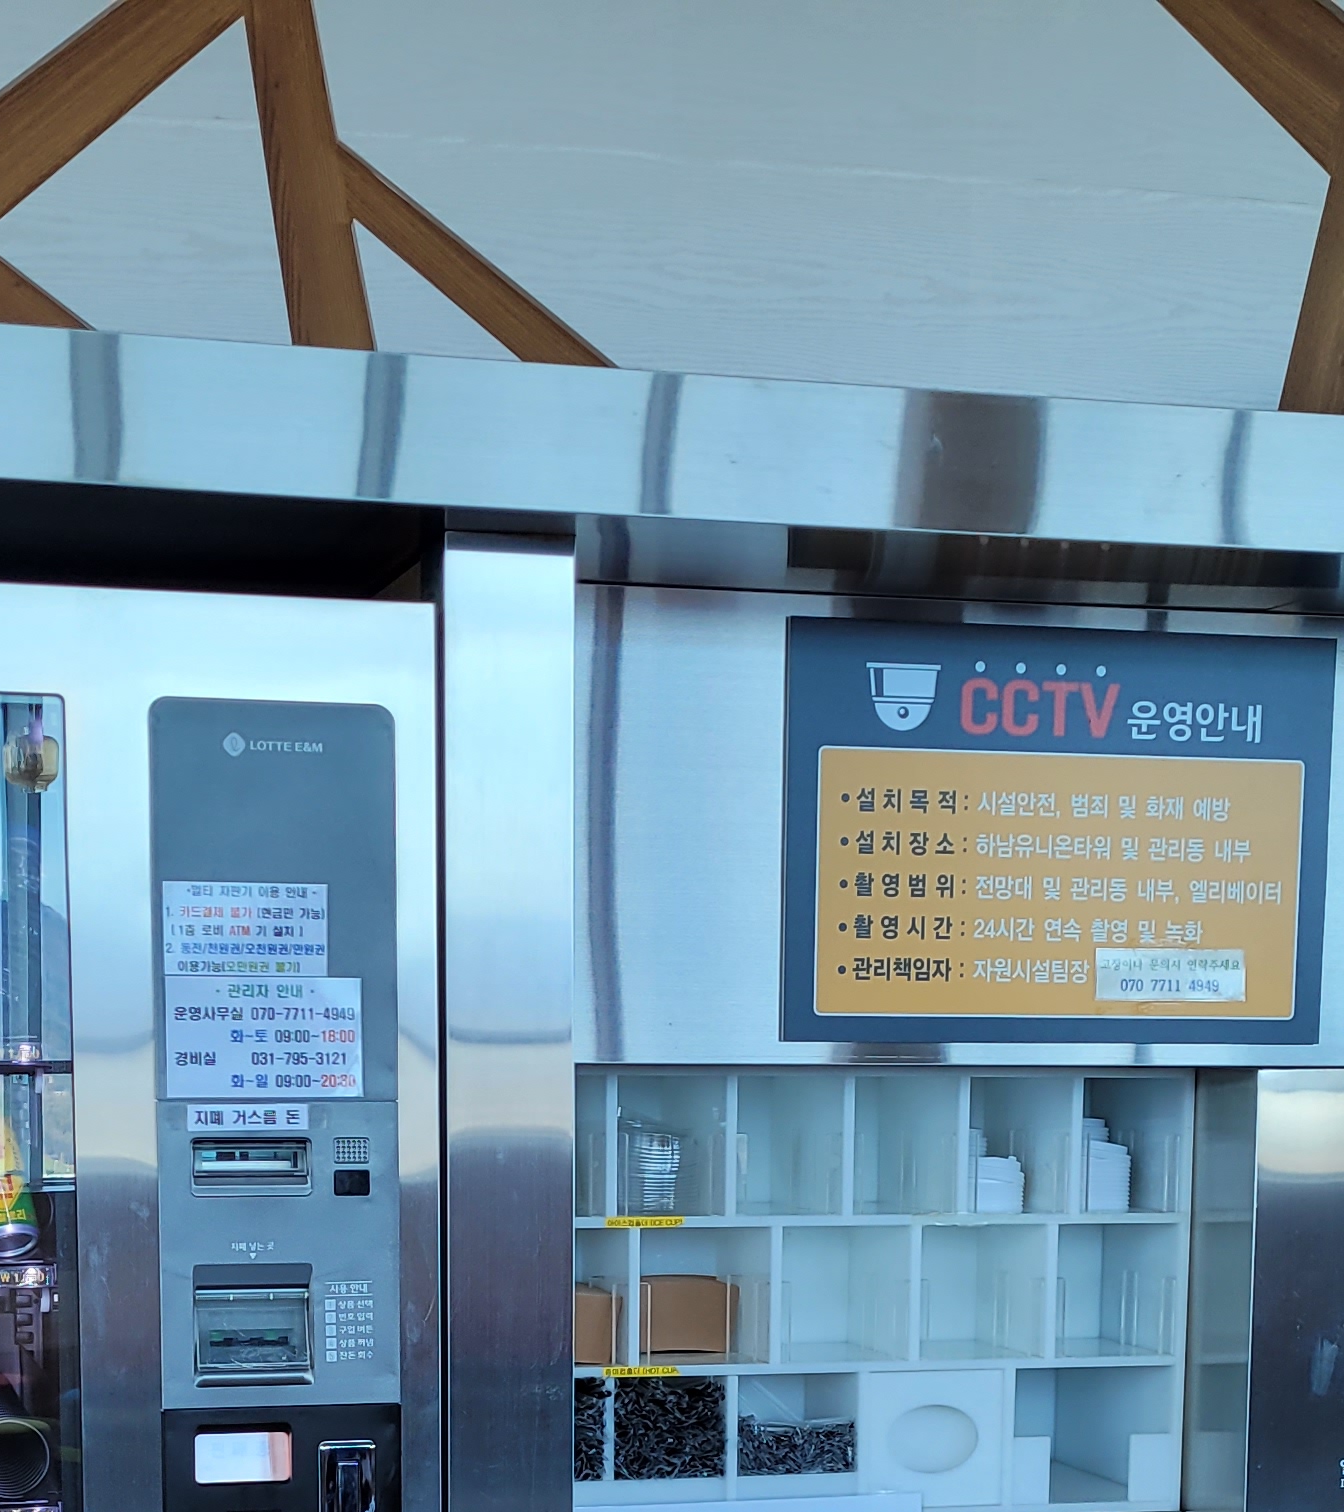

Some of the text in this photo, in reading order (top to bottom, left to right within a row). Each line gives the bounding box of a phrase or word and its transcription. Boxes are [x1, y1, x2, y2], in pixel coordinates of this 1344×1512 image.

[960, 677, 1263, 744] CCTV 운영안내
[250, 739, 323, 754] LOTTE E&M
[977, 792, 1231, 822] 시설안전, 범죄 및 화재 예방
[976, 834, 1251, 863] 하남유니온타워 및 관리동 내부
[975, 875, 1282, 906] 전망대 및 관리동 내부, 엘리베이터
[973, 917, 1203, 945] 24시간 연속 촬영 및 녹화
[972, 958, 1090, 984] 자원시설팀장
[1100, 959, 1240, 972] 고장이나 문의시 연락주세요
[227, 984, 303, 999] 관리자 안내
[1121, 979, 1219, 993] 070 7711 4949
[174, 1007, 355, 1021] 운영사무실 070-7711-4949
[174, 1052, 347, 1066] 경비실 031-795-3121
[194, 1110, 300, 1126] 지폐 거스름 돈
